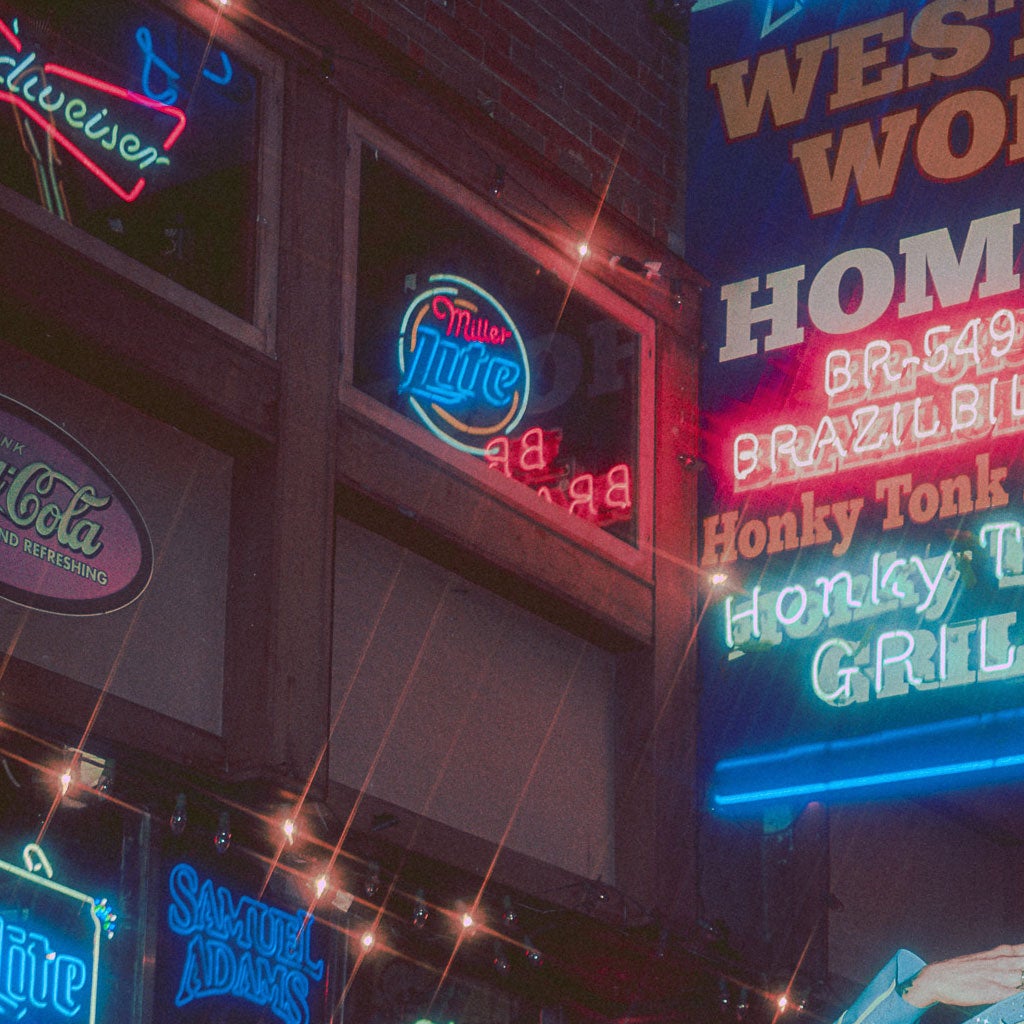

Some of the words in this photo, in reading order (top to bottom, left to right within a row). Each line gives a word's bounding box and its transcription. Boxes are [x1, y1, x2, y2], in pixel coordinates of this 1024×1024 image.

[398, 326, 521, 407] Lite
[431, 296, 512, 345] Miller
[824, 309, 1024, 398] BR-549
[0, 460, 111, 557] -Cola
[701, 488, 864, 566] Honky
[875, 452, 1010, 531] Tonk
[23, 537, 109, 587] REFRESHING
[725, 549, 957, 648] Honky
[0, 914, 87, 1018] ite
[168, 862, 325, 981] SAMUEL
